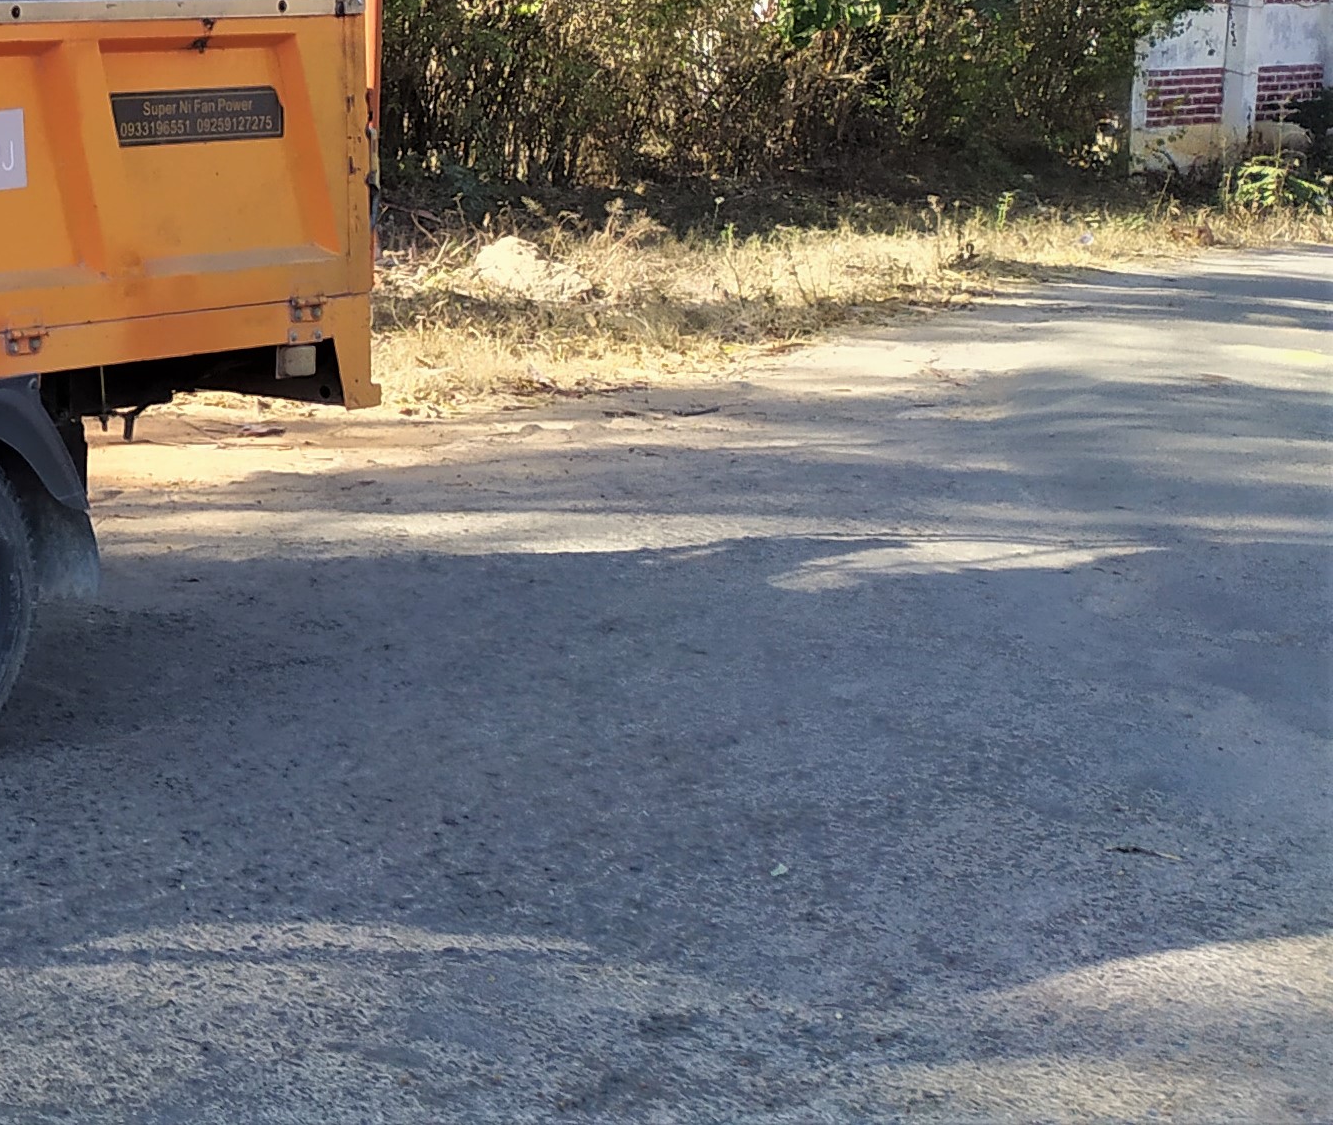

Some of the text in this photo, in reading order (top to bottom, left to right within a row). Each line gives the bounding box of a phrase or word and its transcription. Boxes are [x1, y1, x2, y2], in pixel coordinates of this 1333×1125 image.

[142, 98, 253, 117] Super Ni Fan Power
[196, 115, 273, 133] 09259127275
